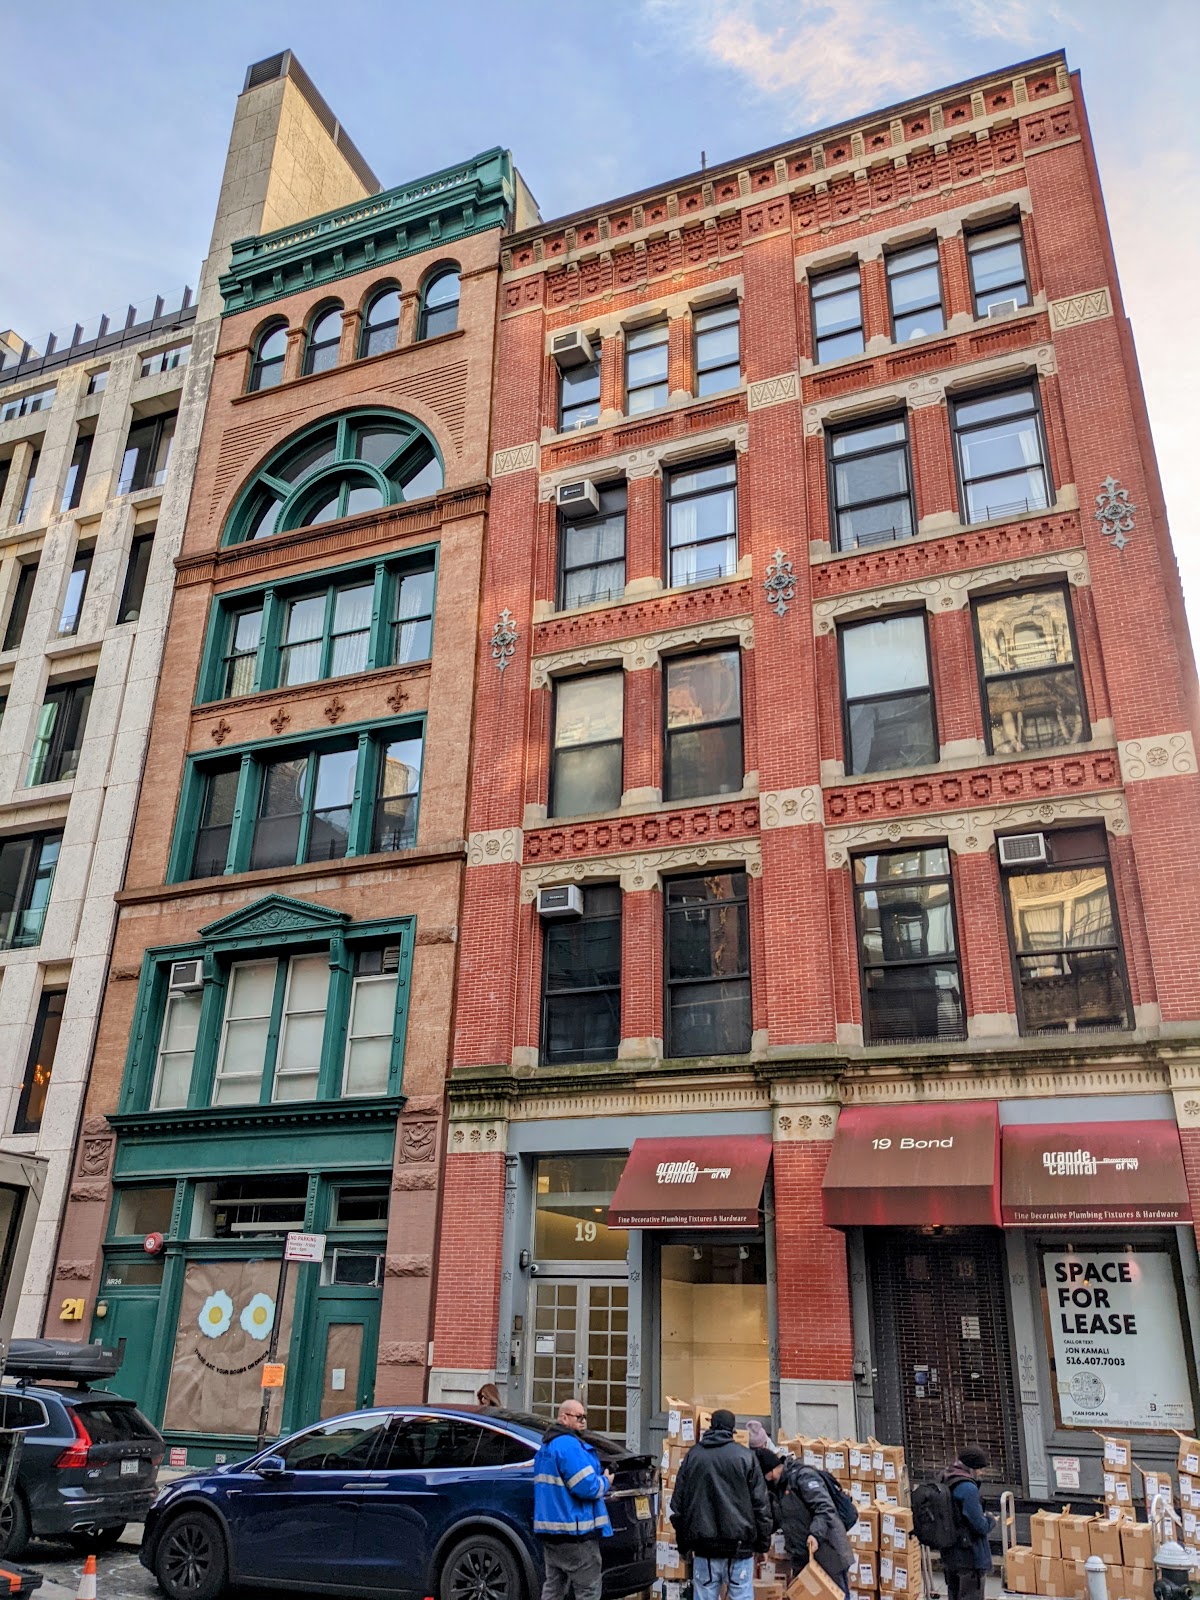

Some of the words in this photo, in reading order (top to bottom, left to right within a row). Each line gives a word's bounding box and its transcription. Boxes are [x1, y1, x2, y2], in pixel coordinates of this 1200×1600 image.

[871, 1137, 892, 1150] 19
[899, 1136, 954, 1149] Bond
[1042, 1149, 1092, 1167] grande
[1049, 1157, 1097, 1175] central
[656, 1160, 696, 1176] grande
[1115, 1163, 1125, 1171] of
[1127, 1162, 1139, 1170] NY
[661, 1215, 688, 1223] Plumbing
[1030, 1212, 1067, 1220] Decorative
[1069, 1211, 1103, 1220] Plumbing
[1104, 1211, 1134, 1219] Fixtures
[1143, 1210, 1179, 1218] Hardware
[575, 1221, 597, 1242] 19
[1054, 1262, 1132, 1283] SPACE
[1057, 1287, 1111, 1308] FOR
[59, 1298, 86, 1320] 21
[1061, 1313, 1138, 1335] LEASE
[1081, 1347, 1110, 1355] KAMALI
[1066, 1356, 1126, 1366] 516.407.7003
[1103, 1418, 1129, 1426] Plumbing
[1129, 1419, 1151, 1427] Fixtures
